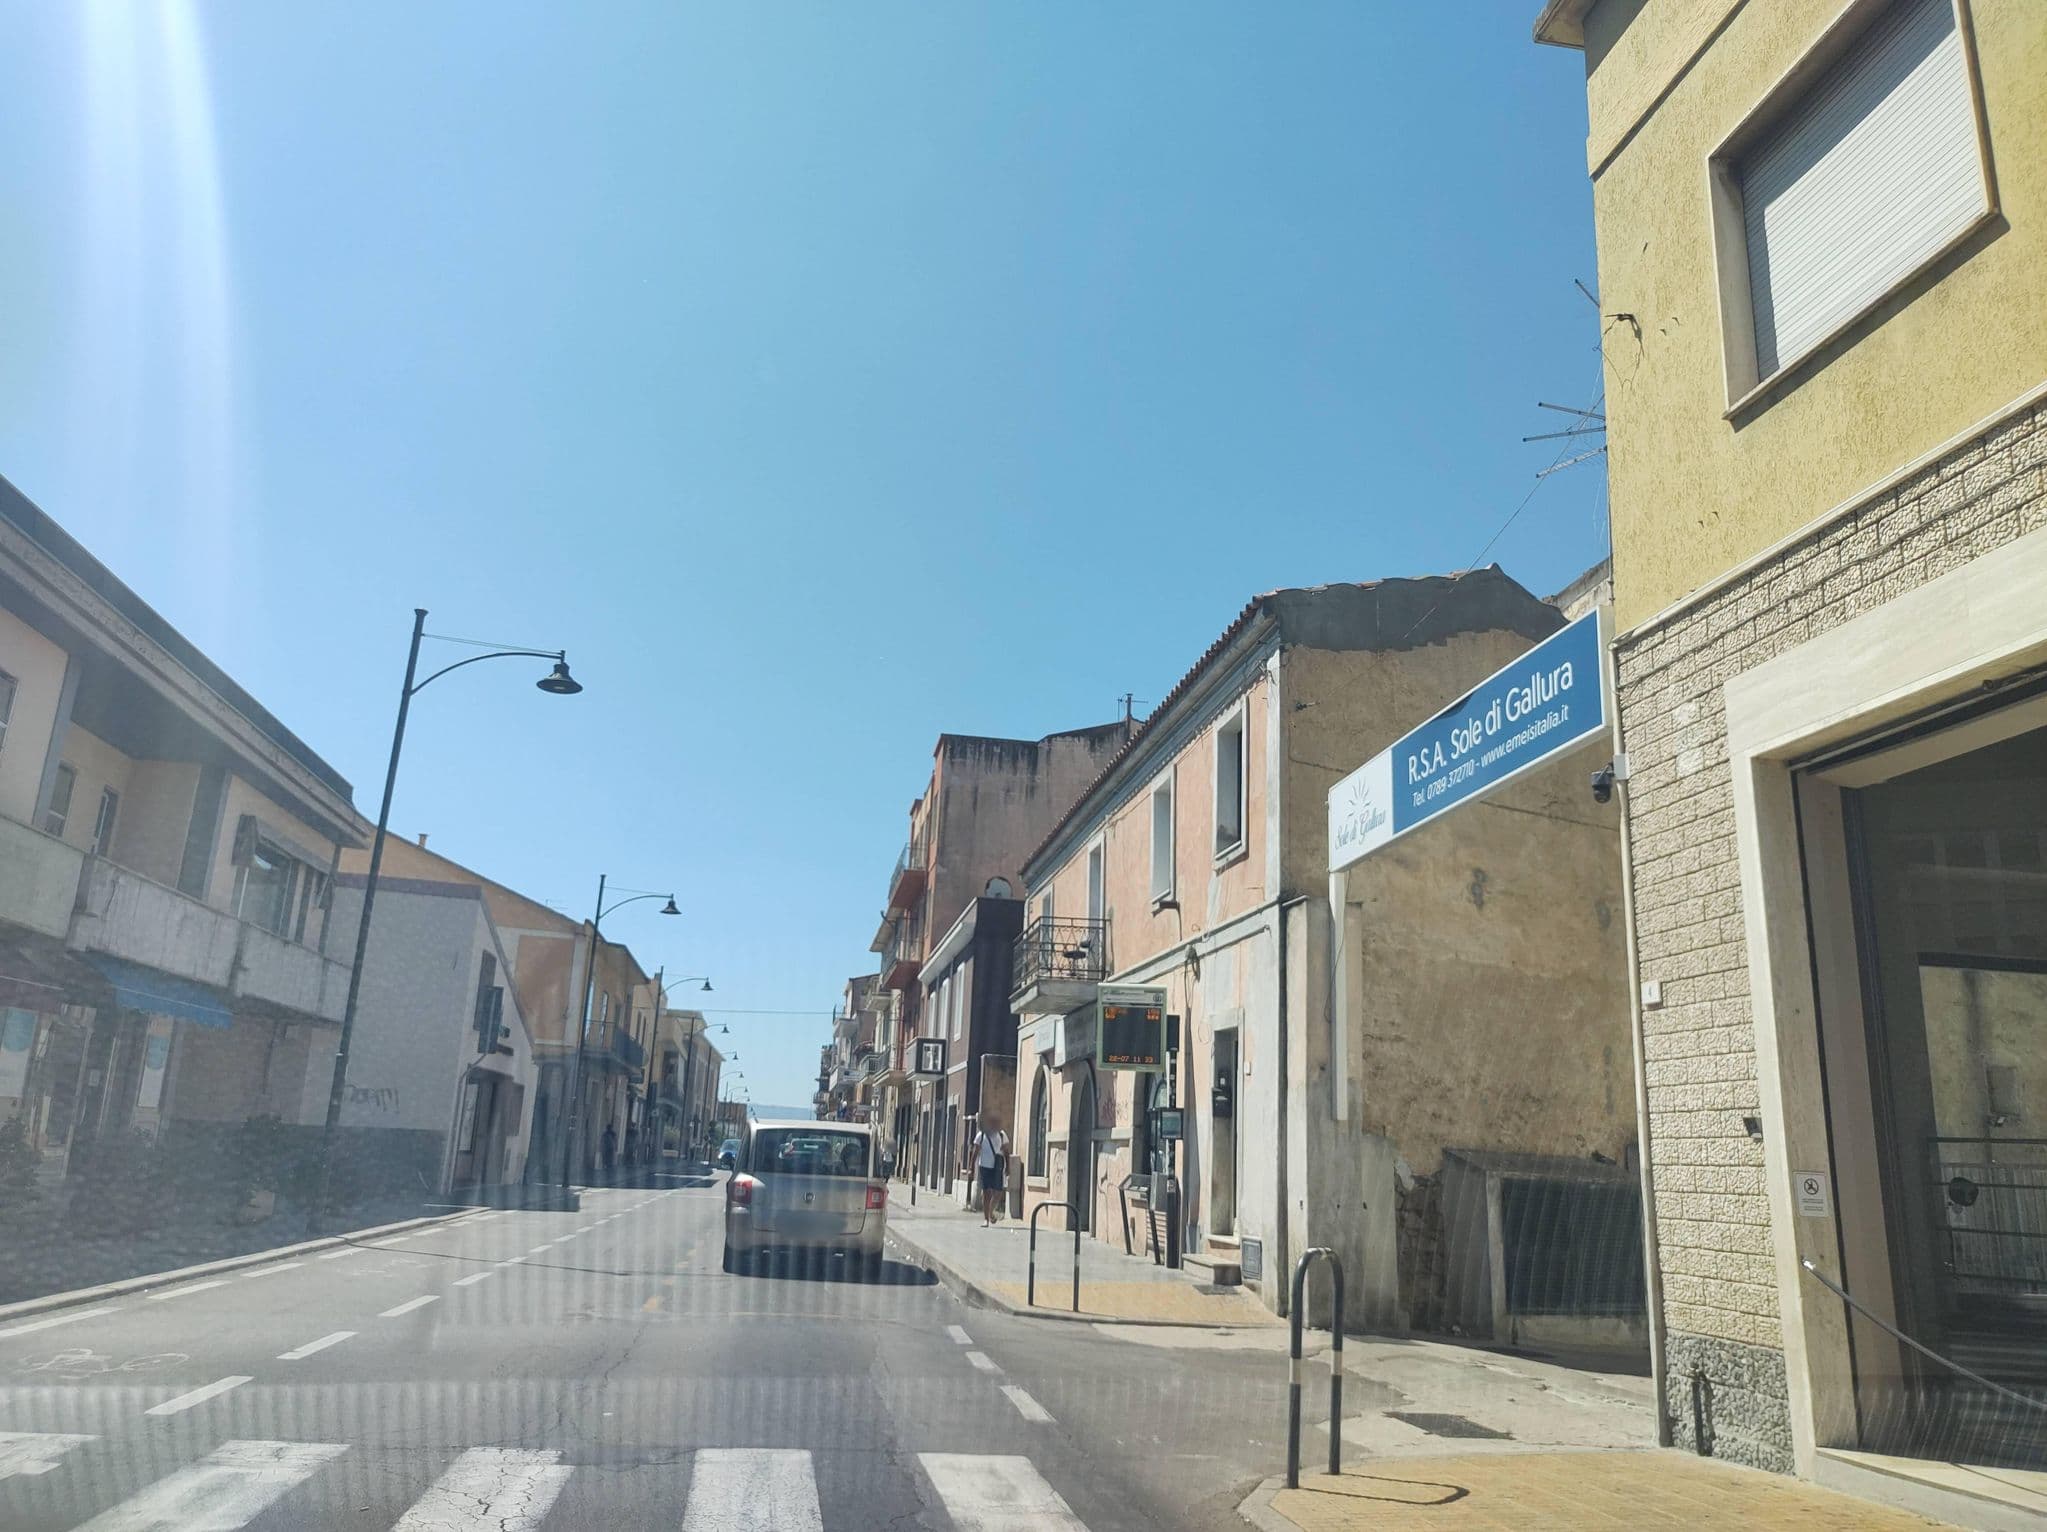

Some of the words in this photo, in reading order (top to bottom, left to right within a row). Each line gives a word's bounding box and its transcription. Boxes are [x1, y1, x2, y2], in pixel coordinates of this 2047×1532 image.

[1408, 741, 1448, 785] R.S.A.
[1450, 716, 1482, 760] Sole
[1485, 698, 1502, 736] di
[1505, 661, 1573, 722] Gallura
[1427, 776, 1447, 800] 0789
[1447, 759, 1475, 788] 372710
[1480, 704, 1569, 769] www.emeisitalia.it
